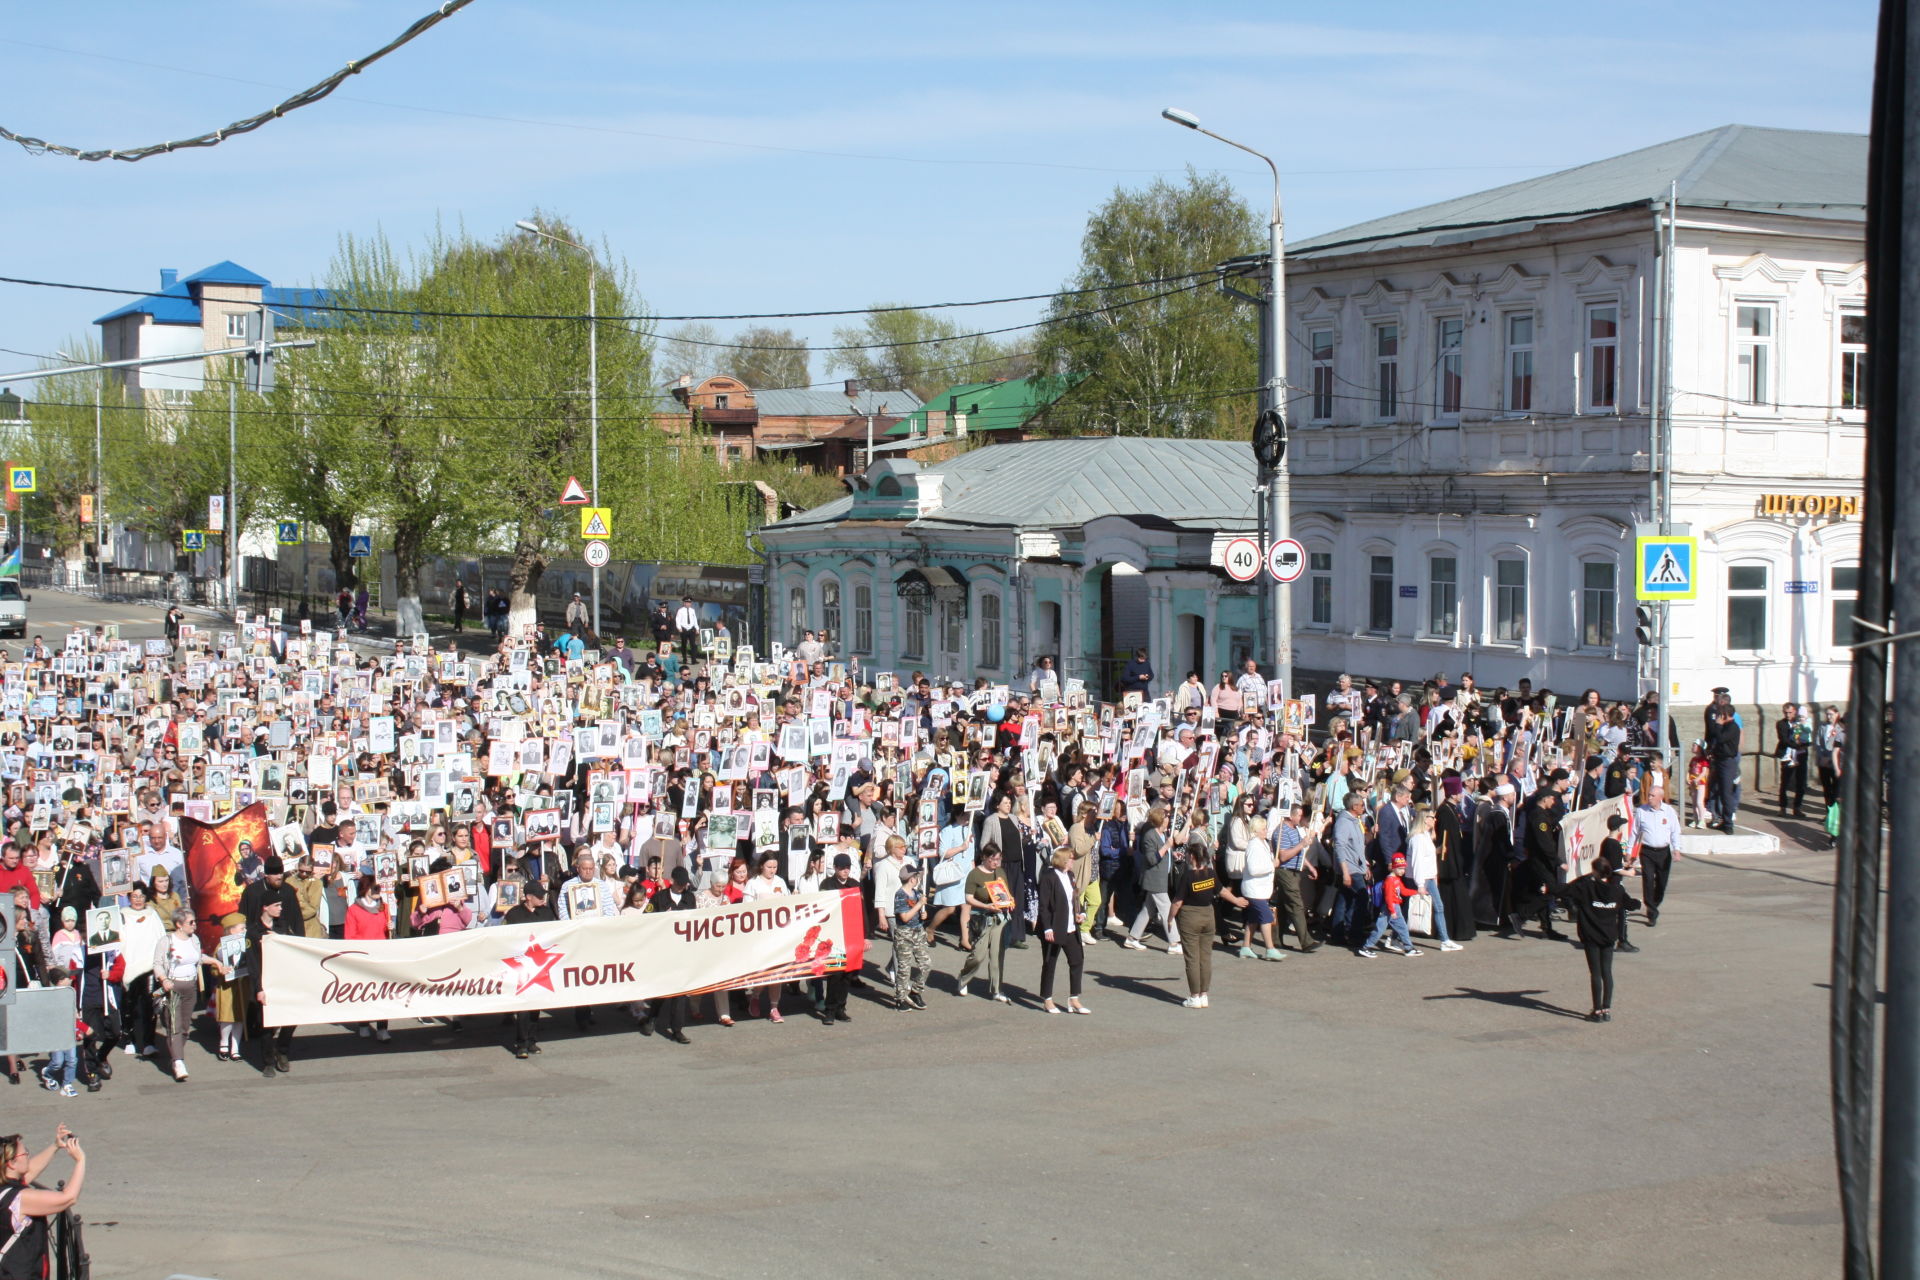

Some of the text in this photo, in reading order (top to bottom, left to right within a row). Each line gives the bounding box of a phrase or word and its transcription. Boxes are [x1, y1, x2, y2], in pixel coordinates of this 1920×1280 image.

[1762, 494, 1859, 515] ШТОРЫ
[591, 549, 603, 559] 20
[1233, 552, 1252, 567] 40
[563, 962, 636, 988] ПОЛК
